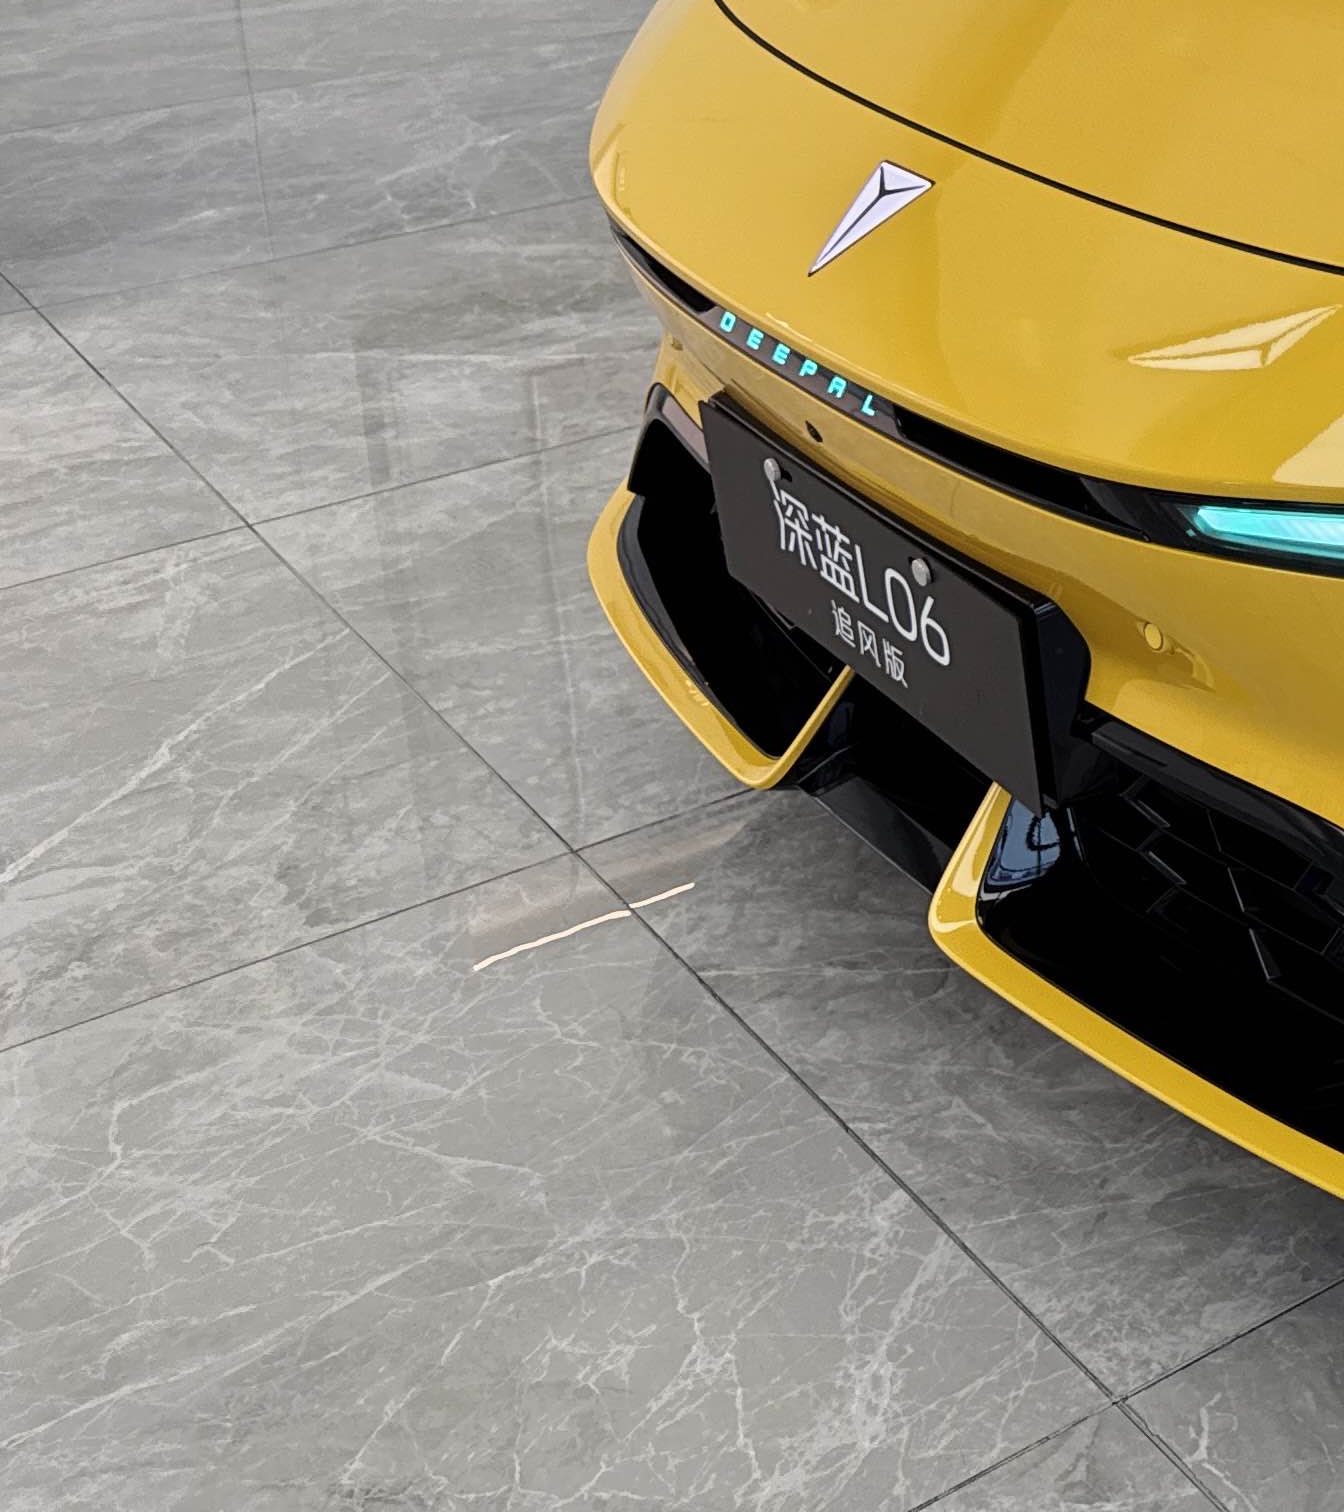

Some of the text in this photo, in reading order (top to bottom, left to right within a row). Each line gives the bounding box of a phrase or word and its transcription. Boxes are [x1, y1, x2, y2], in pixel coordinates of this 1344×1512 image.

[720, 310, 876, 417] DEEPAL
[772, 480, 951, 667] 深蓝L06
[830, 598, 909, 689] 追风版
